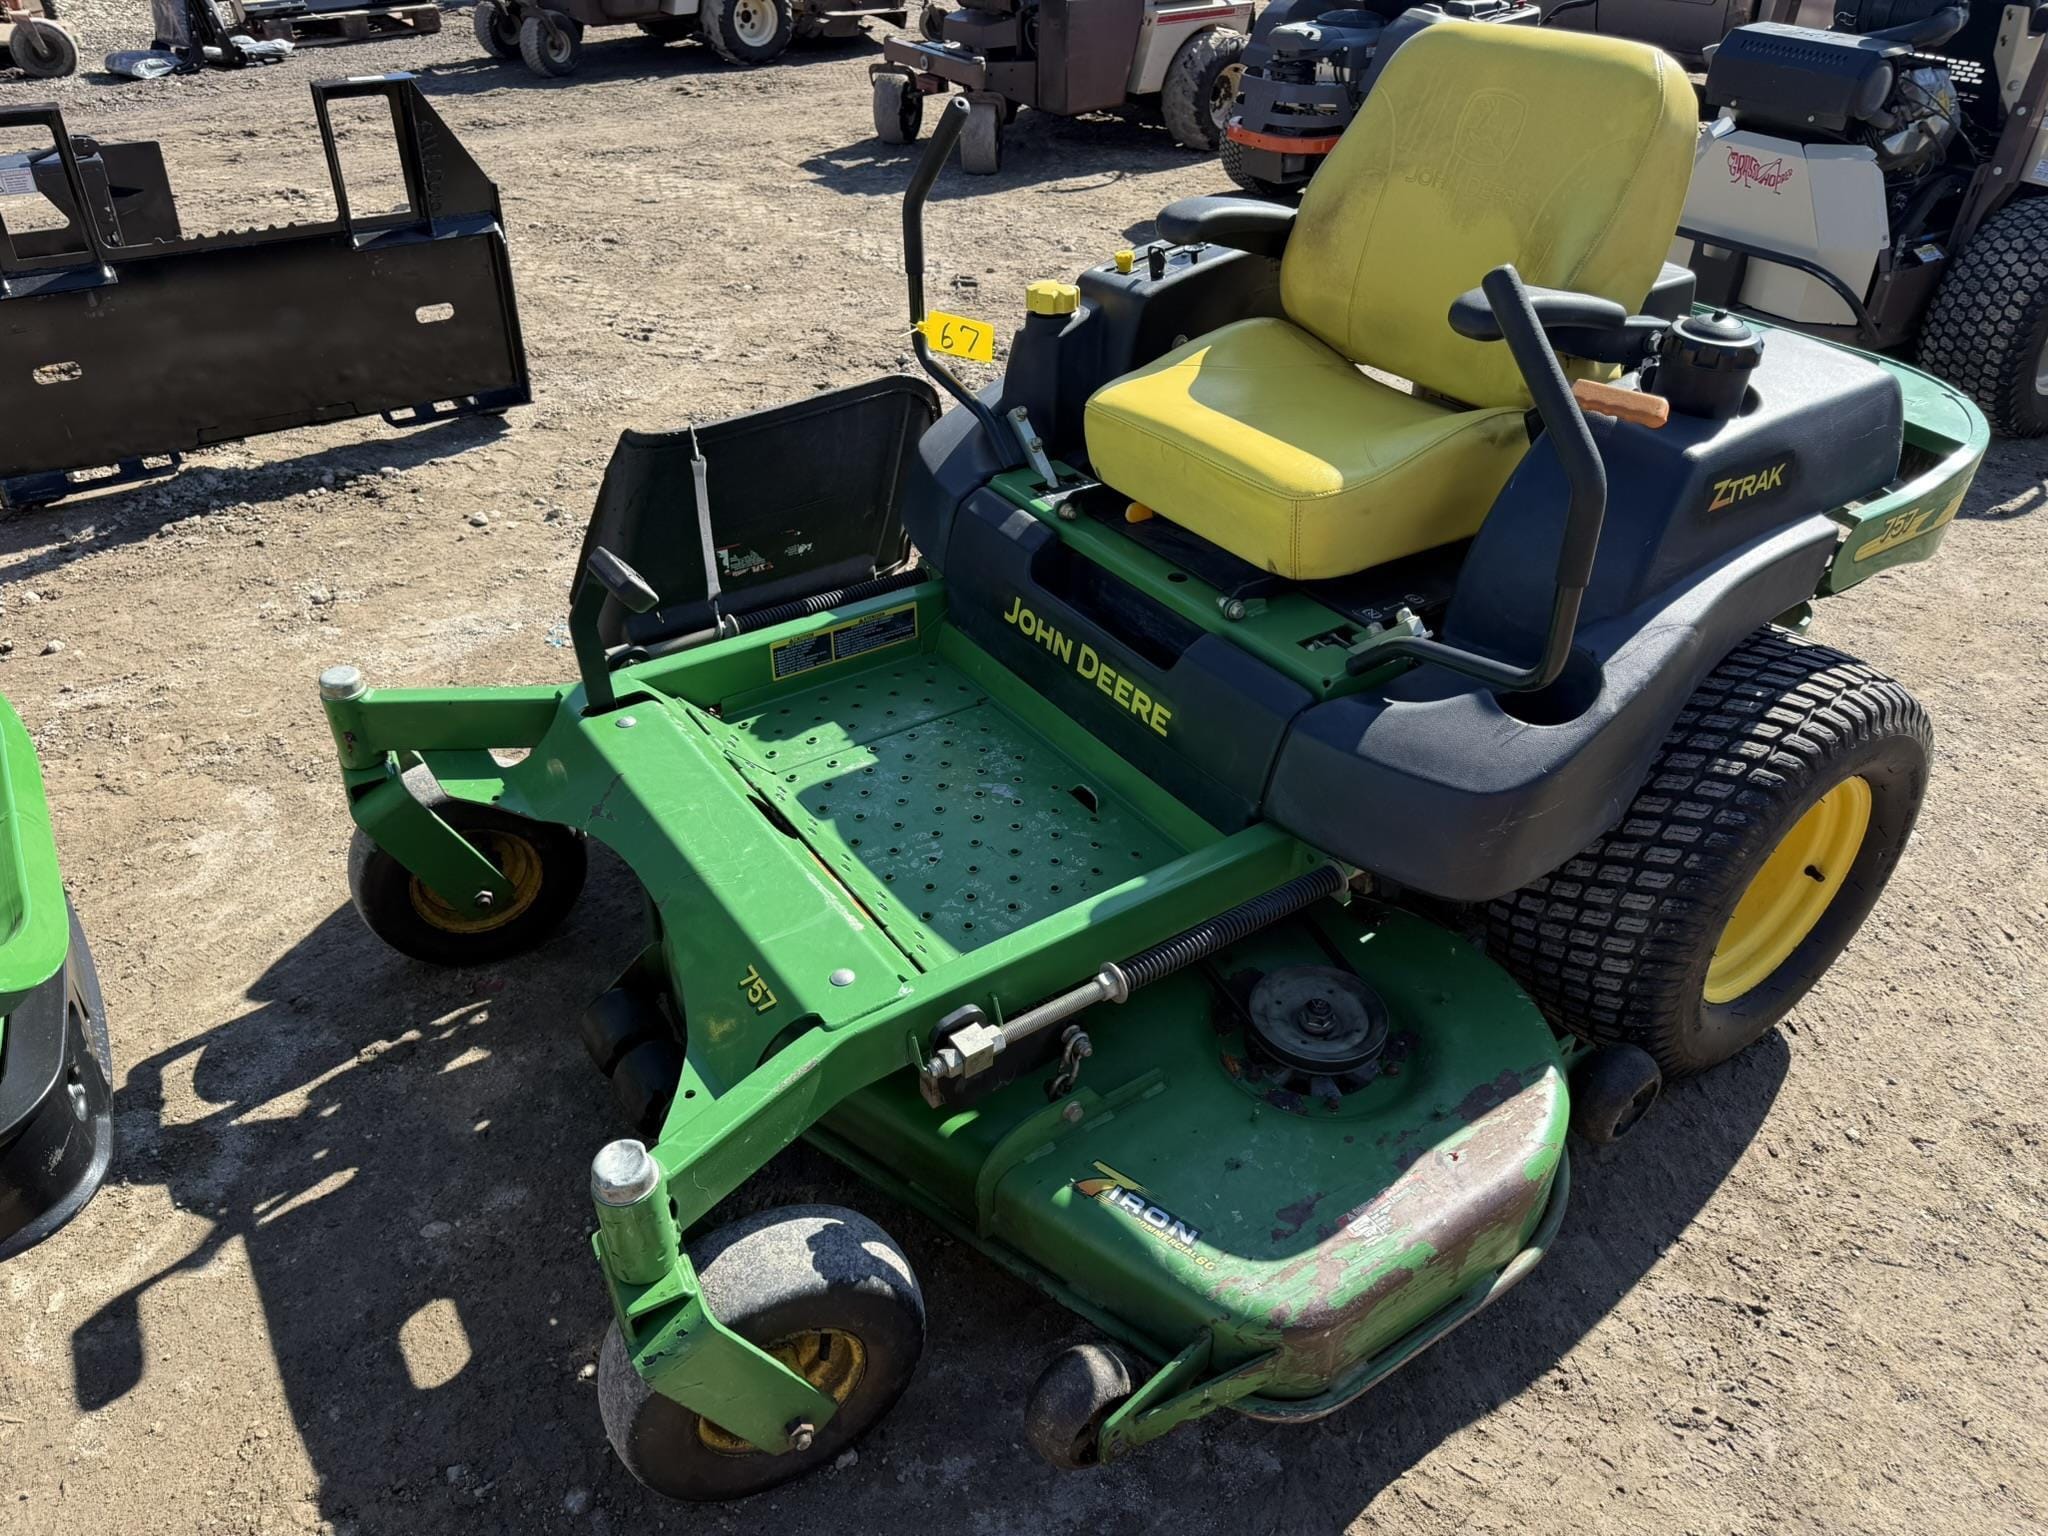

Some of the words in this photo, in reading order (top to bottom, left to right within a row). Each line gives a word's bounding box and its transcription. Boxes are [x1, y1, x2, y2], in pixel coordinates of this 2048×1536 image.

[941, 322, 979, 353] 67
[1707, 462, 1787, 513] ZTRAK
[1880, 507, 1920, 543] 757
[1003, 596, 1073, 665] JOHN
[1076, 643, 1172, 737] DEERE
[739, 964, 778, 1012] 757
